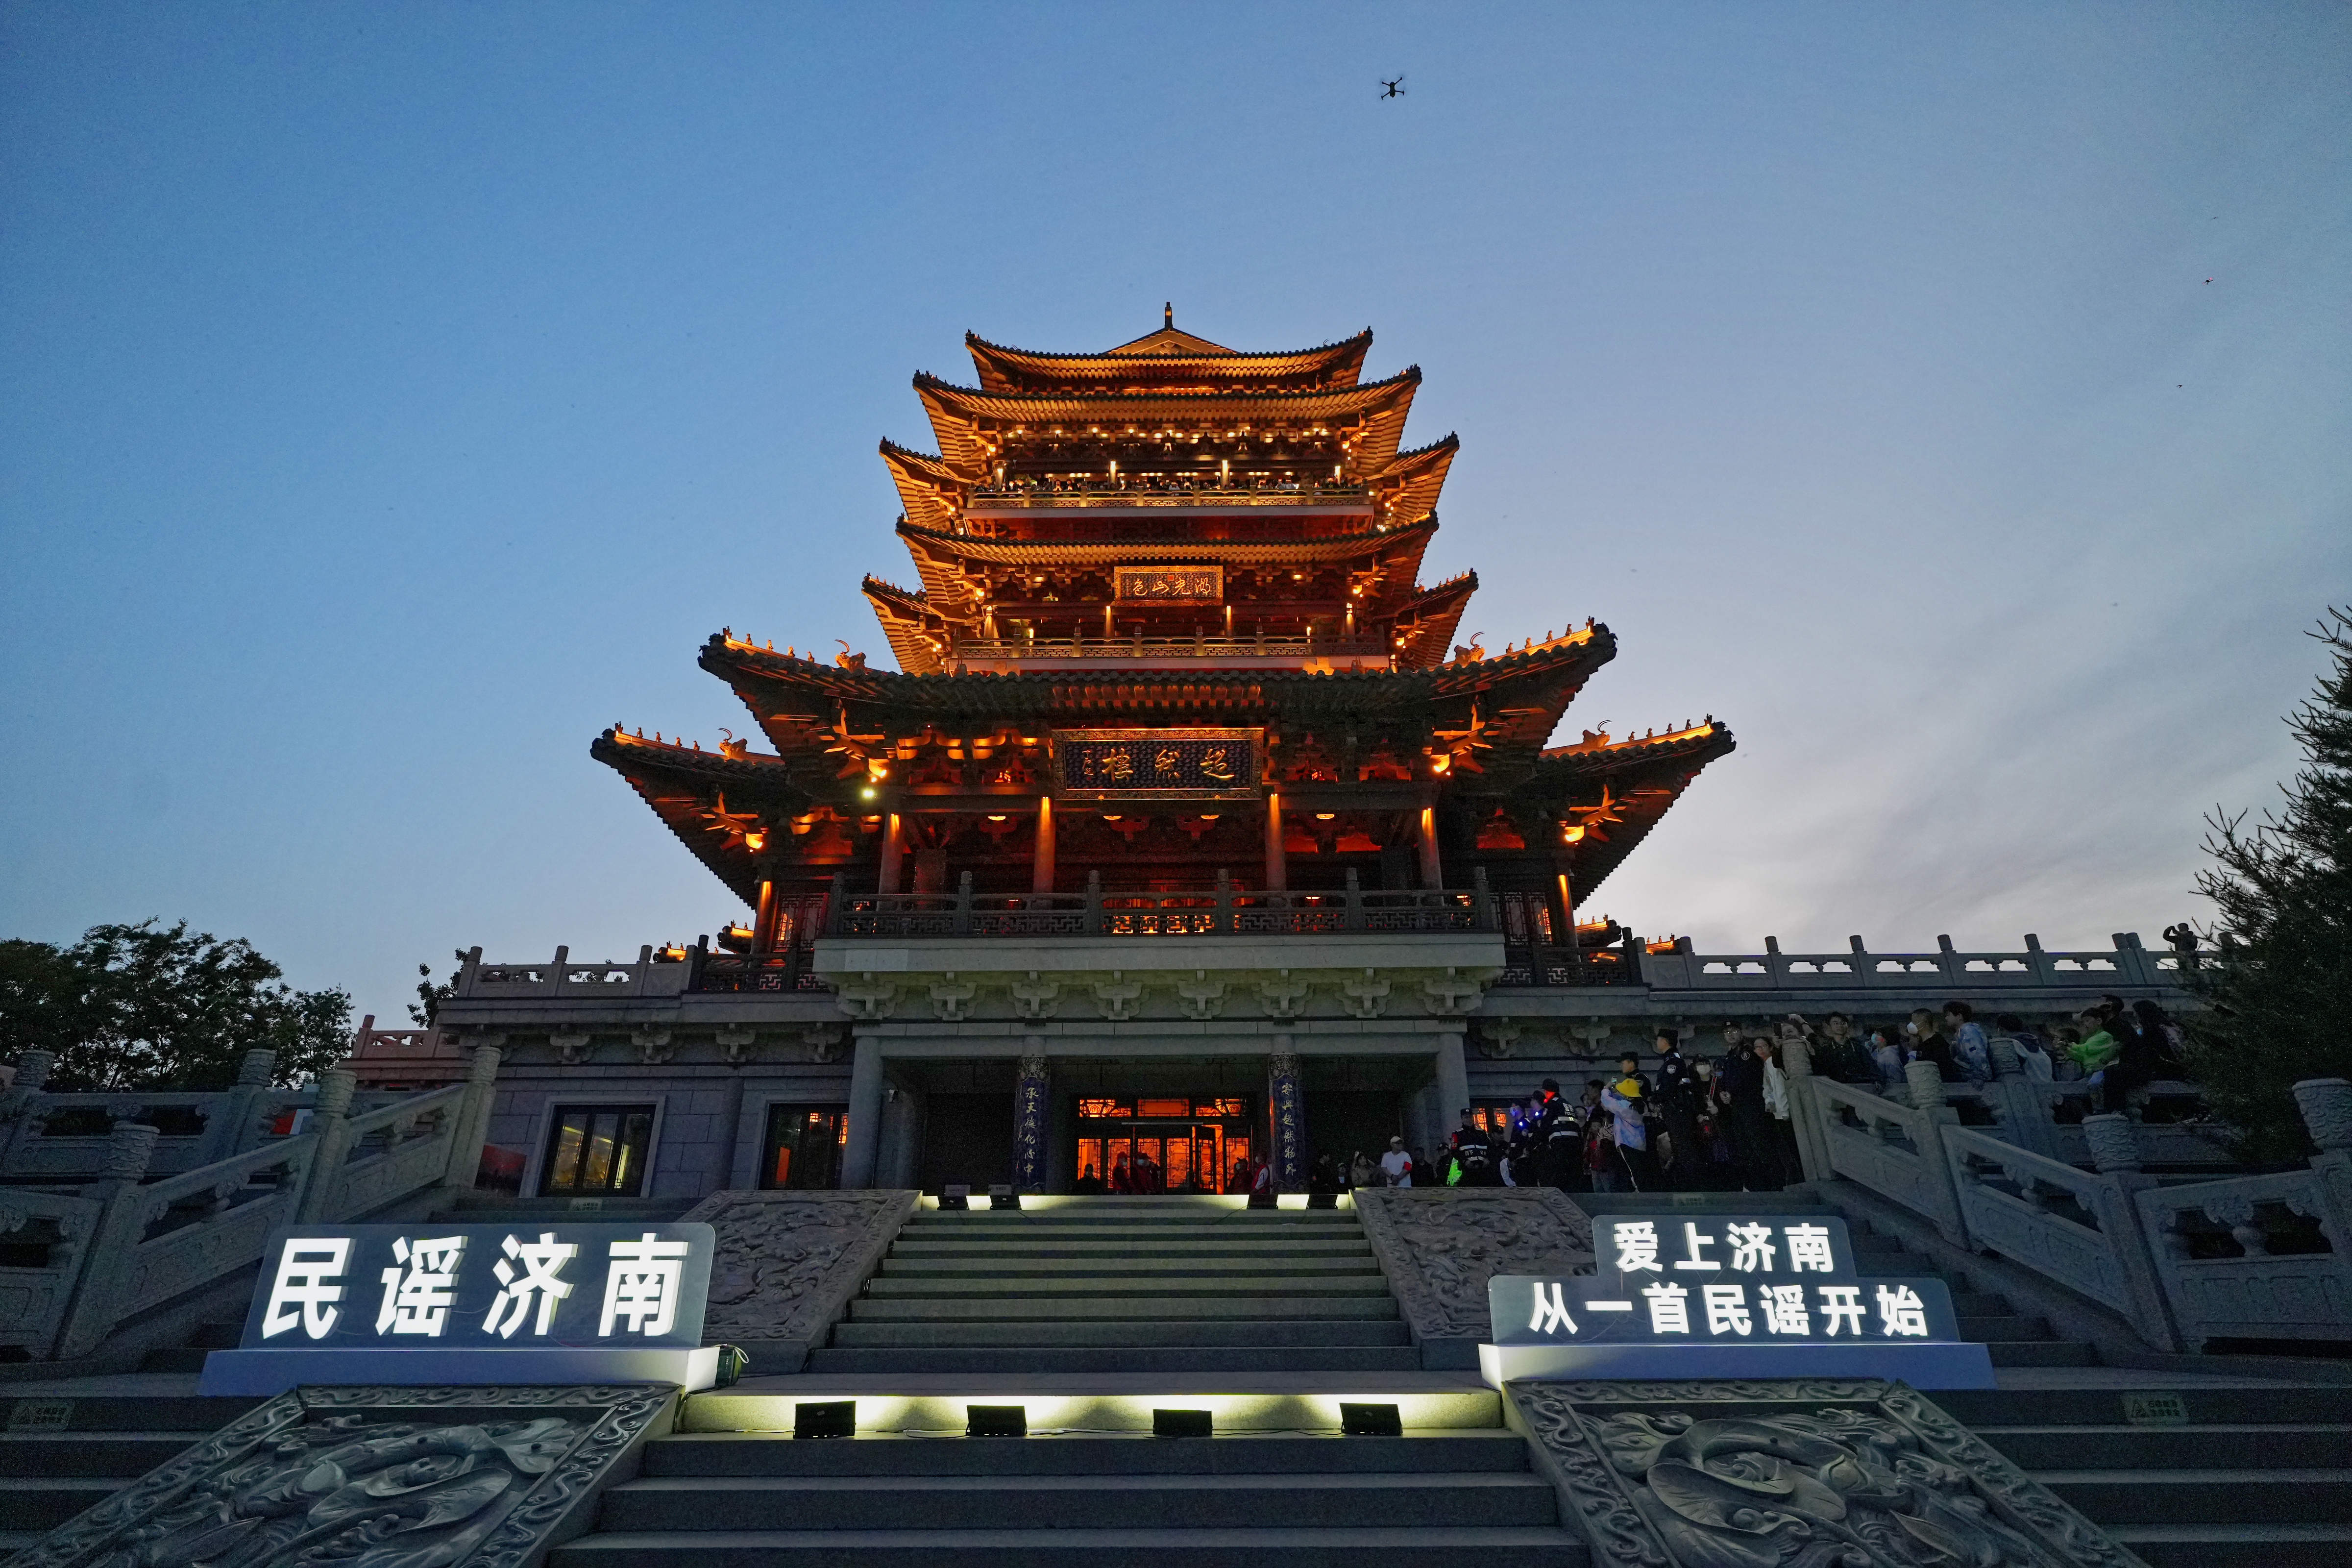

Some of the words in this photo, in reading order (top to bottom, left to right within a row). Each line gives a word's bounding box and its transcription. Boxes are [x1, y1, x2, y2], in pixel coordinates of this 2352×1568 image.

[1614, 1221, 1833, 1273] 爱上济南
[262, 1231, 690, 1340] 民谣济南
[1528, 1281, 1929, 1338] 从一首民谣开始
